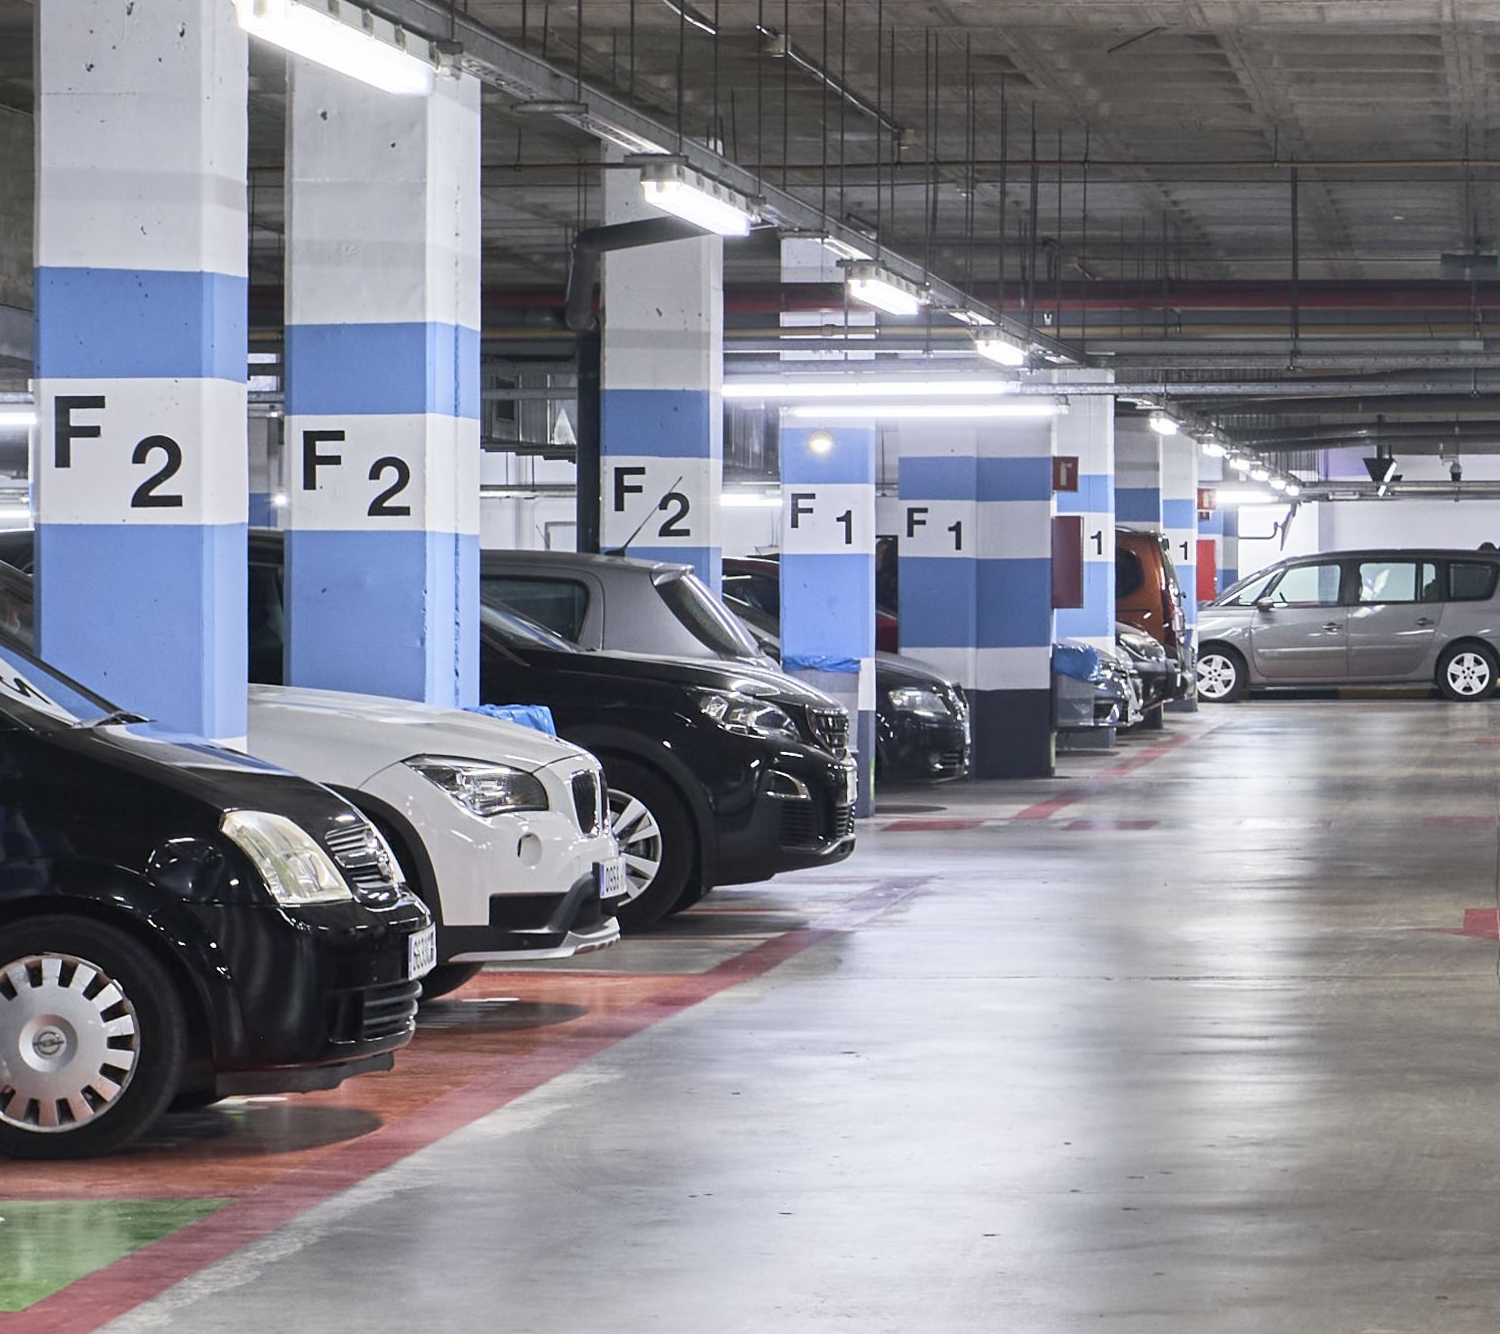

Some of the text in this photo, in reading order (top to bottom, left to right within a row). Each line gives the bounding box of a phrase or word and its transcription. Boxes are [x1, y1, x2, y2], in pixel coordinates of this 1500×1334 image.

[54, 395, 183, 508] F 2
[302, 429, 411, 517] F 2
[613, 466, 691, 538] F 2
[790, 492, 853, 545] F 1
[906, 507, 962, 551] F 1
[1090, 530, 1103, 556] 1
[1179, 541, 1188, 561] 1
